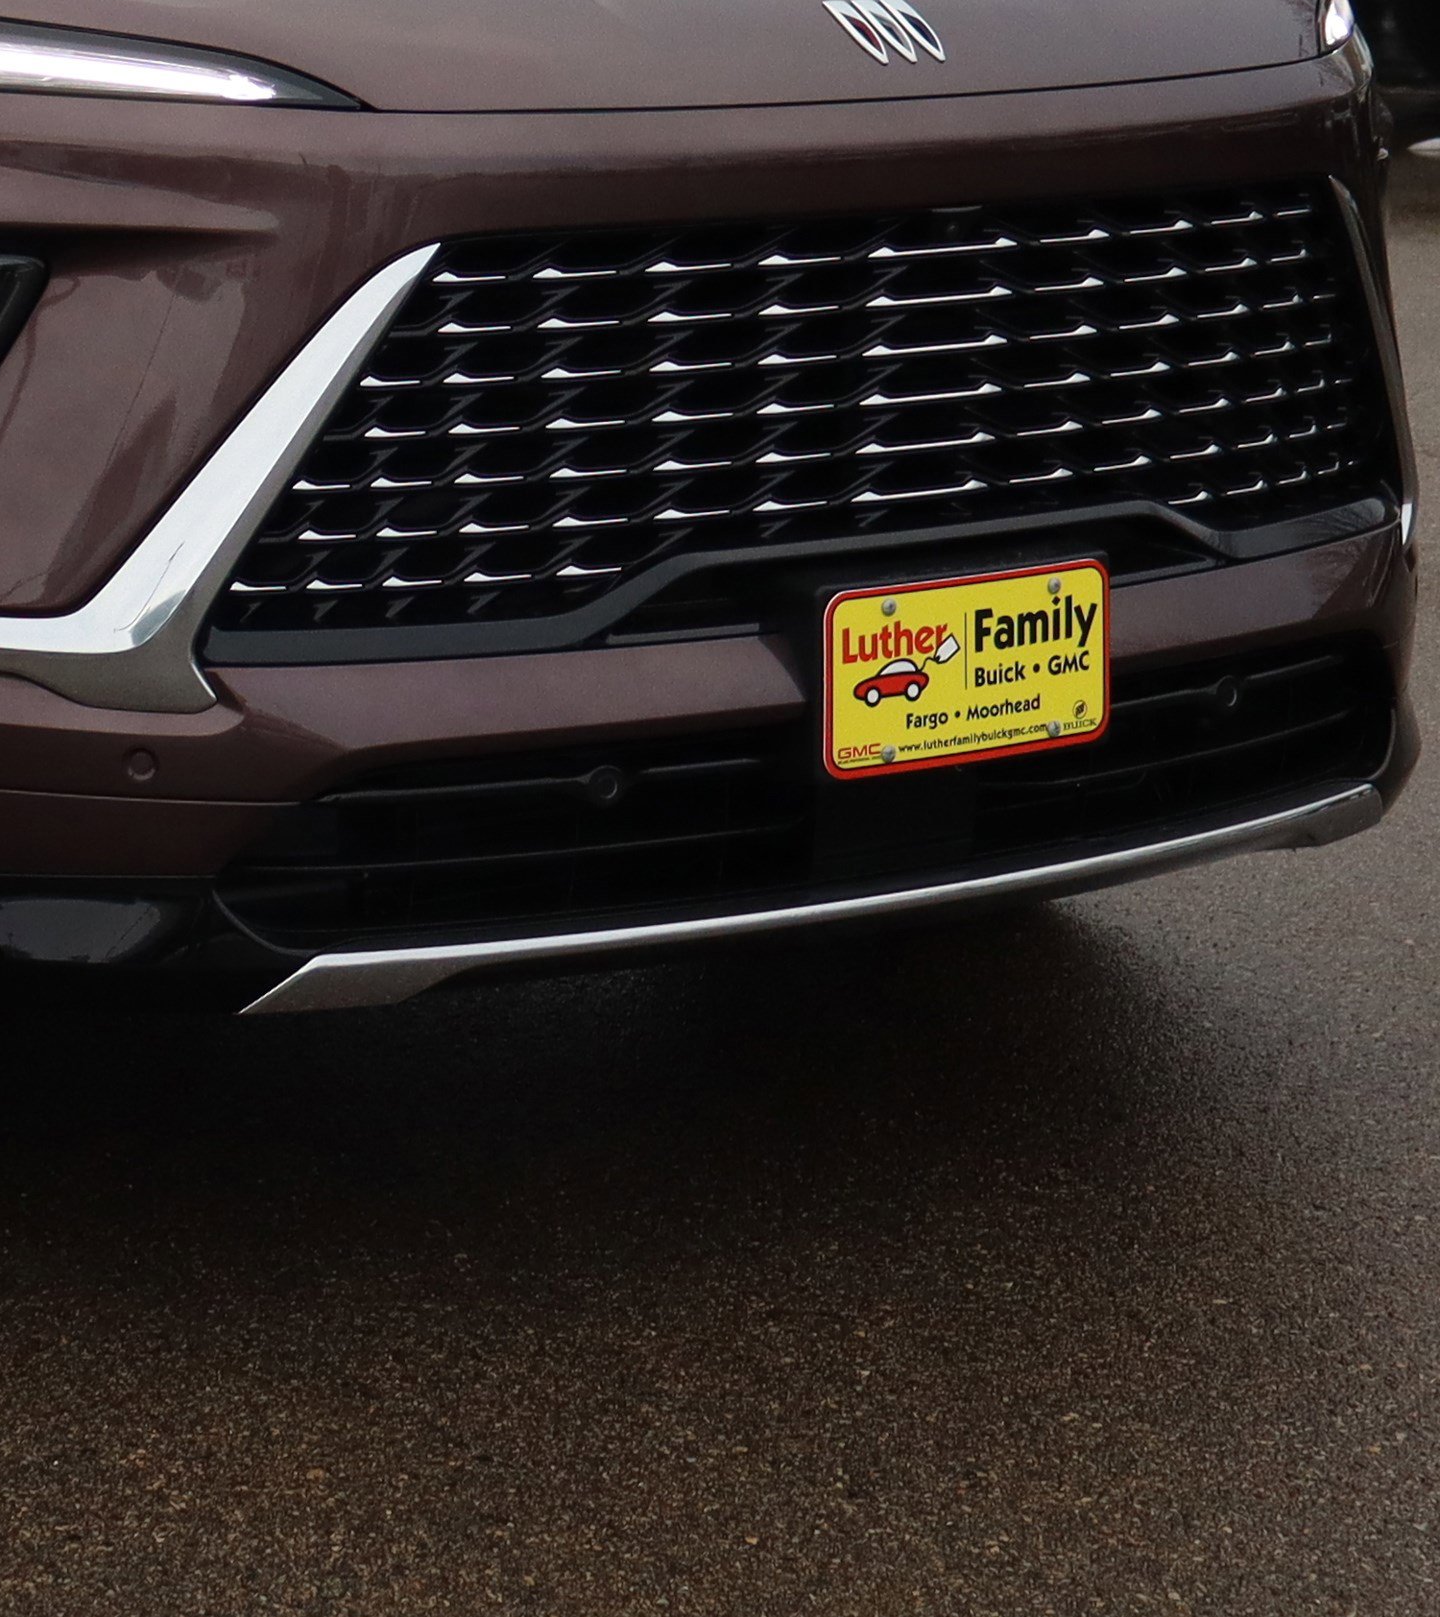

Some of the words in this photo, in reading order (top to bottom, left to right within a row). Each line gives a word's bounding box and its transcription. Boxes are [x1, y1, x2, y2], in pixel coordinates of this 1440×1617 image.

[975, 594, 1097, 653] Family
[842, 620, 949, 664] Luther
[975, 661, 1026, 688] Buick
[1048, 650, 1090, 676] GMC
[906, 712, 948, 729] Fargo
[966, 694, 1041, 721] Moorhead
[837, 743, 881, 760] GMC
[898, 723, 1048, 753] www.lutherfamilybuickgmc.com
